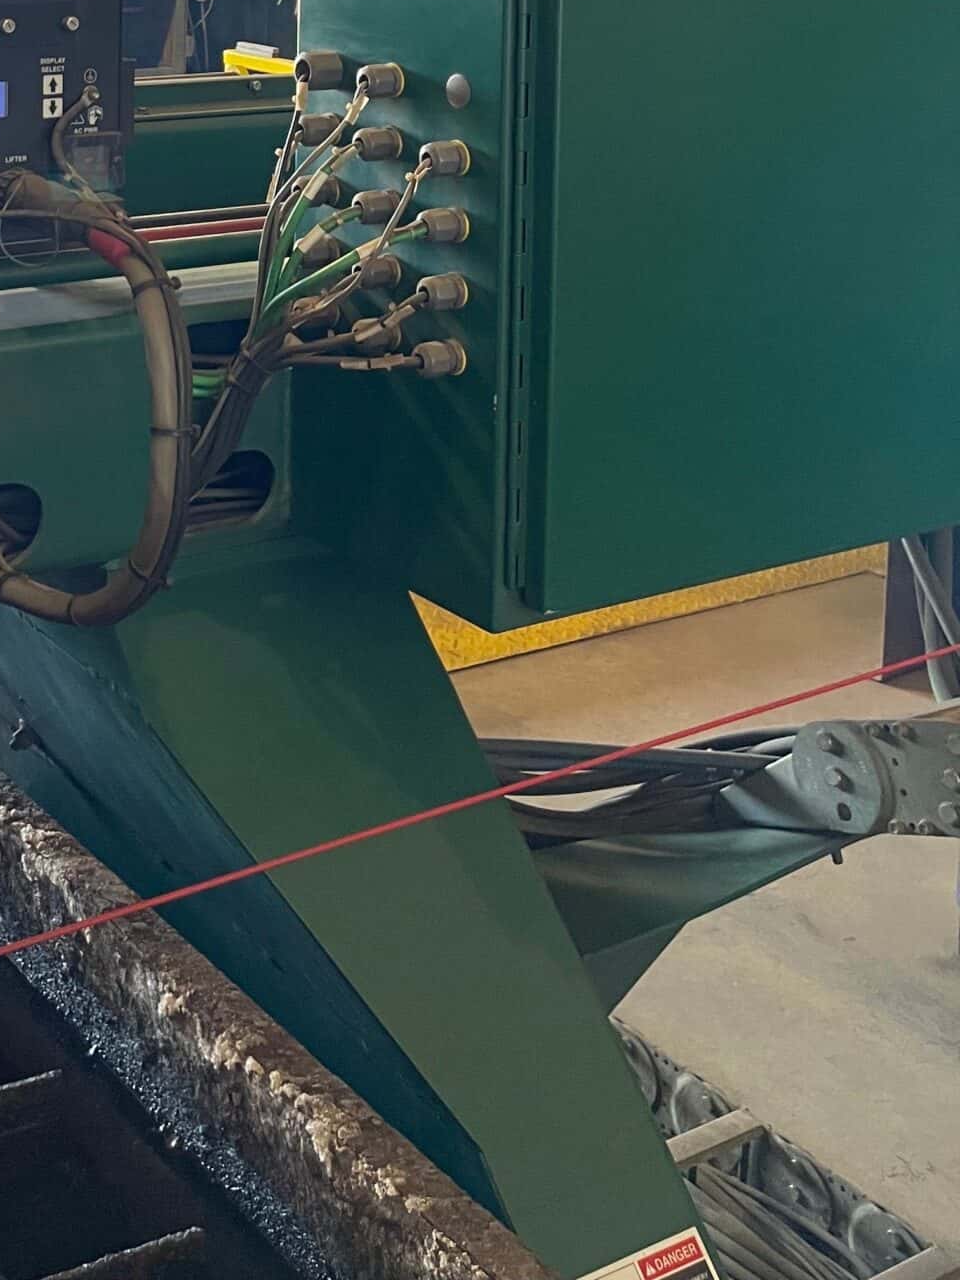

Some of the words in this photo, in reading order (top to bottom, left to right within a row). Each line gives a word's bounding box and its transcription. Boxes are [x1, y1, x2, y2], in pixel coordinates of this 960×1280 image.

[40, 57, 66, 65] DISPLAY
[41, 65, 65, 73] SELECT
[5, 155, 28, 164] LIFTER
[654, 1242, 698, 1271] DANGER
